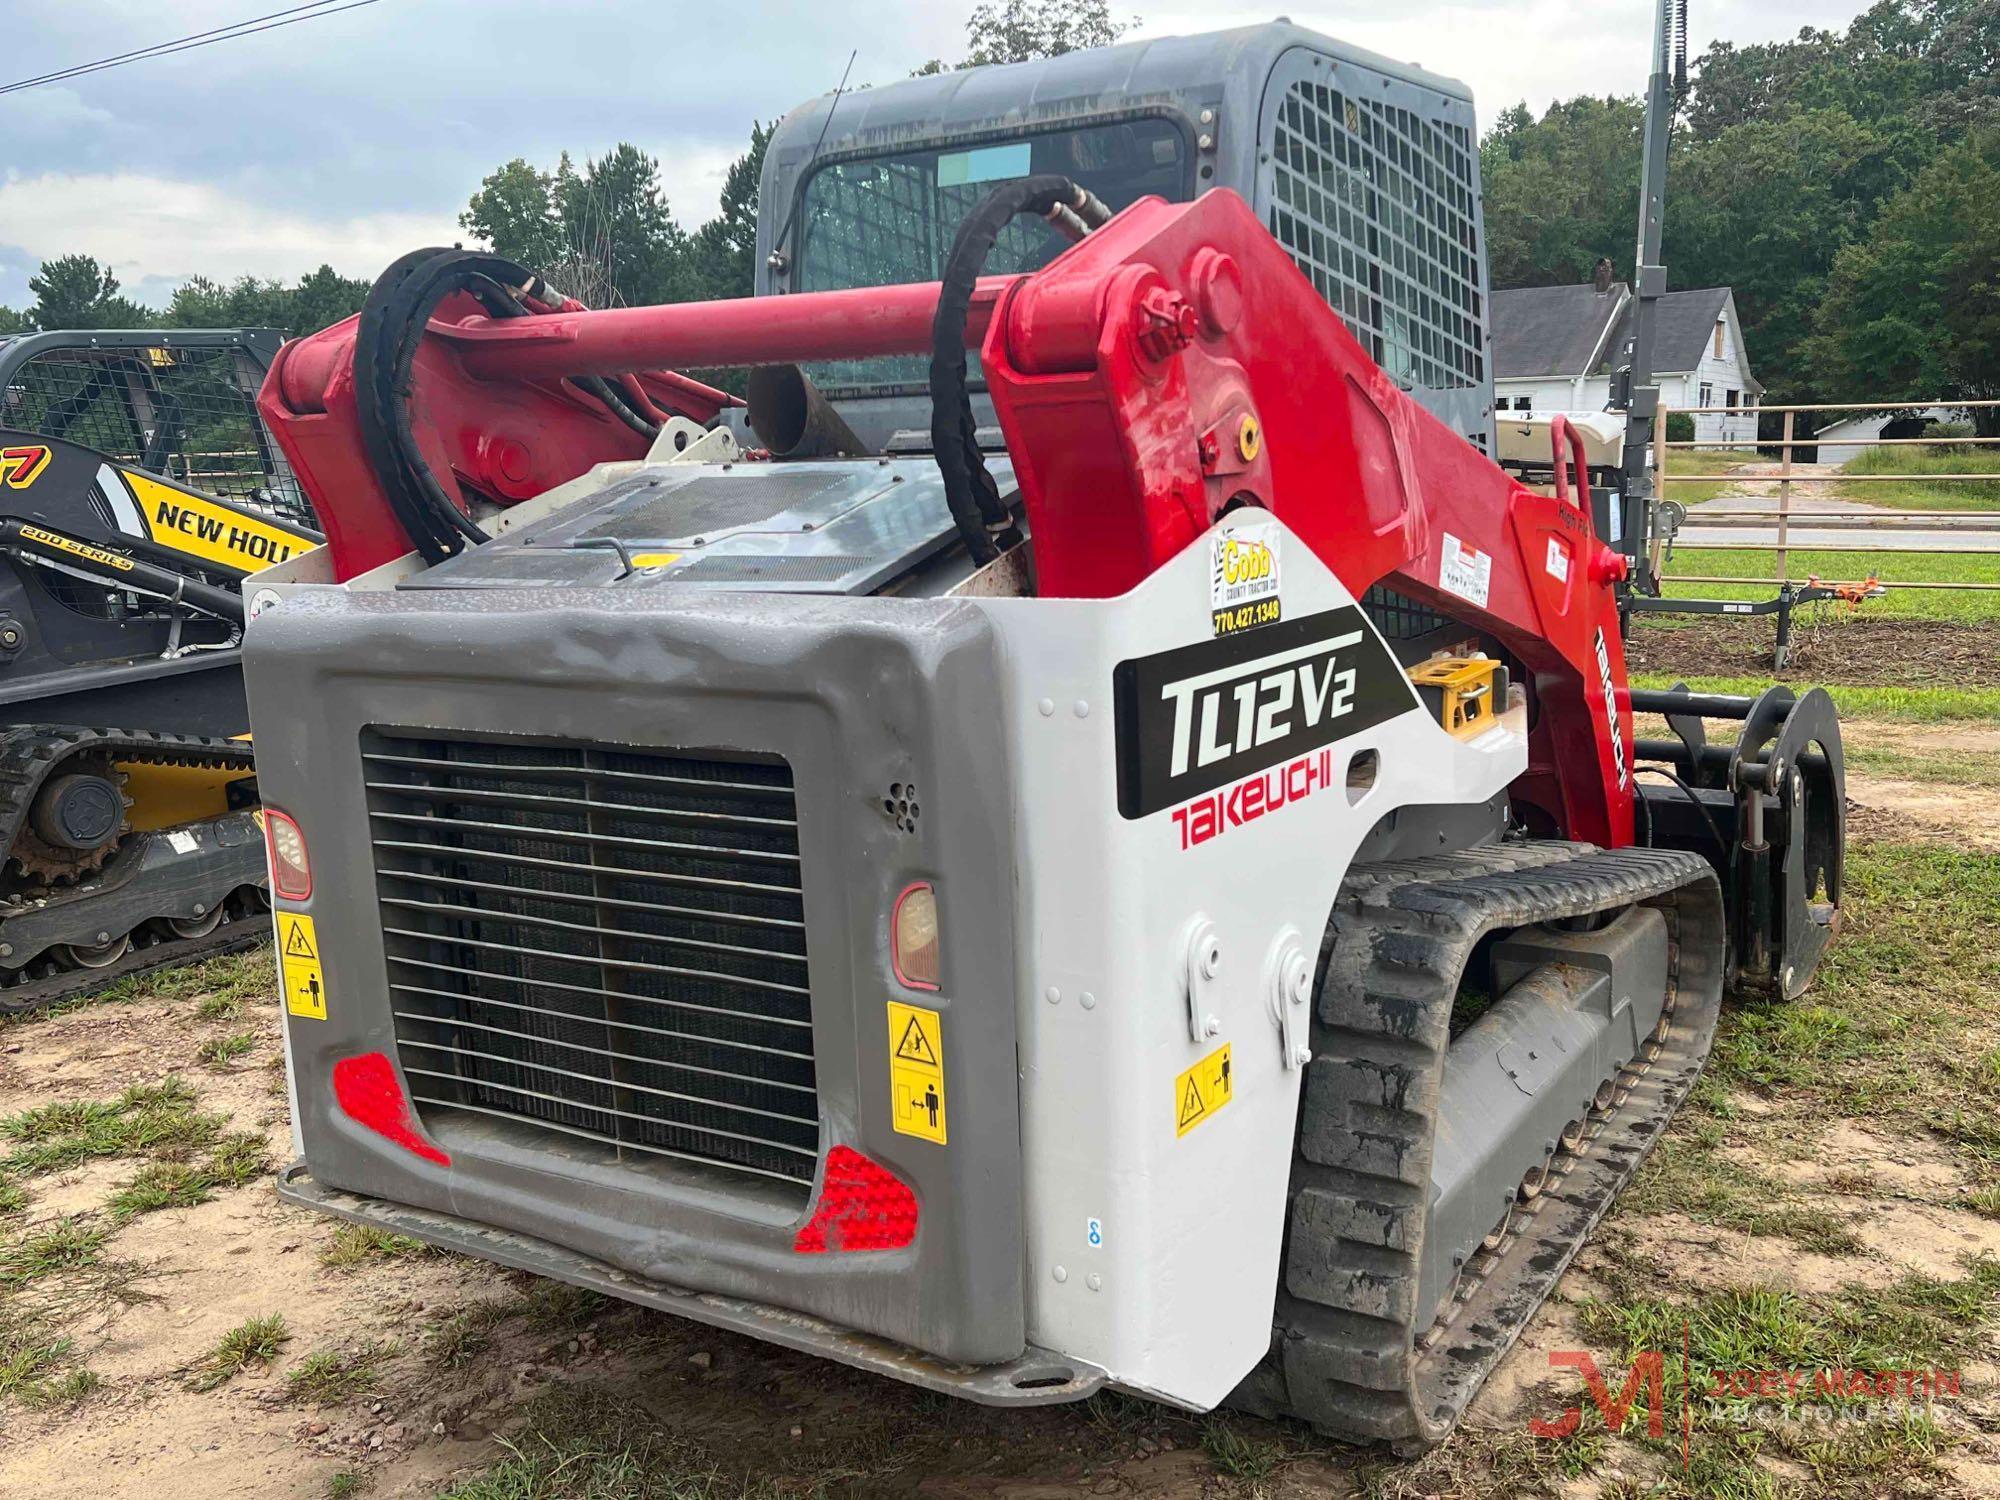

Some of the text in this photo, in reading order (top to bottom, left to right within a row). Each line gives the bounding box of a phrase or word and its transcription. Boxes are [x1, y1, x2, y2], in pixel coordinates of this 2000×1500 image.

[0, 445, 52, 489] 7
[22, 526, 132, 569] 200 SERIES
[156, 501, 304, 565] NEW HOLL
[1224, 538, 1271, 585] Cobb
[1227, 584, 1247, 600] COUNTY
[1248, 580, 1269, 596] TRACTOR
[1161, 630, 1363, 778] TL12V2
[1172, 749, 1331, 850] TAKEUCHI
